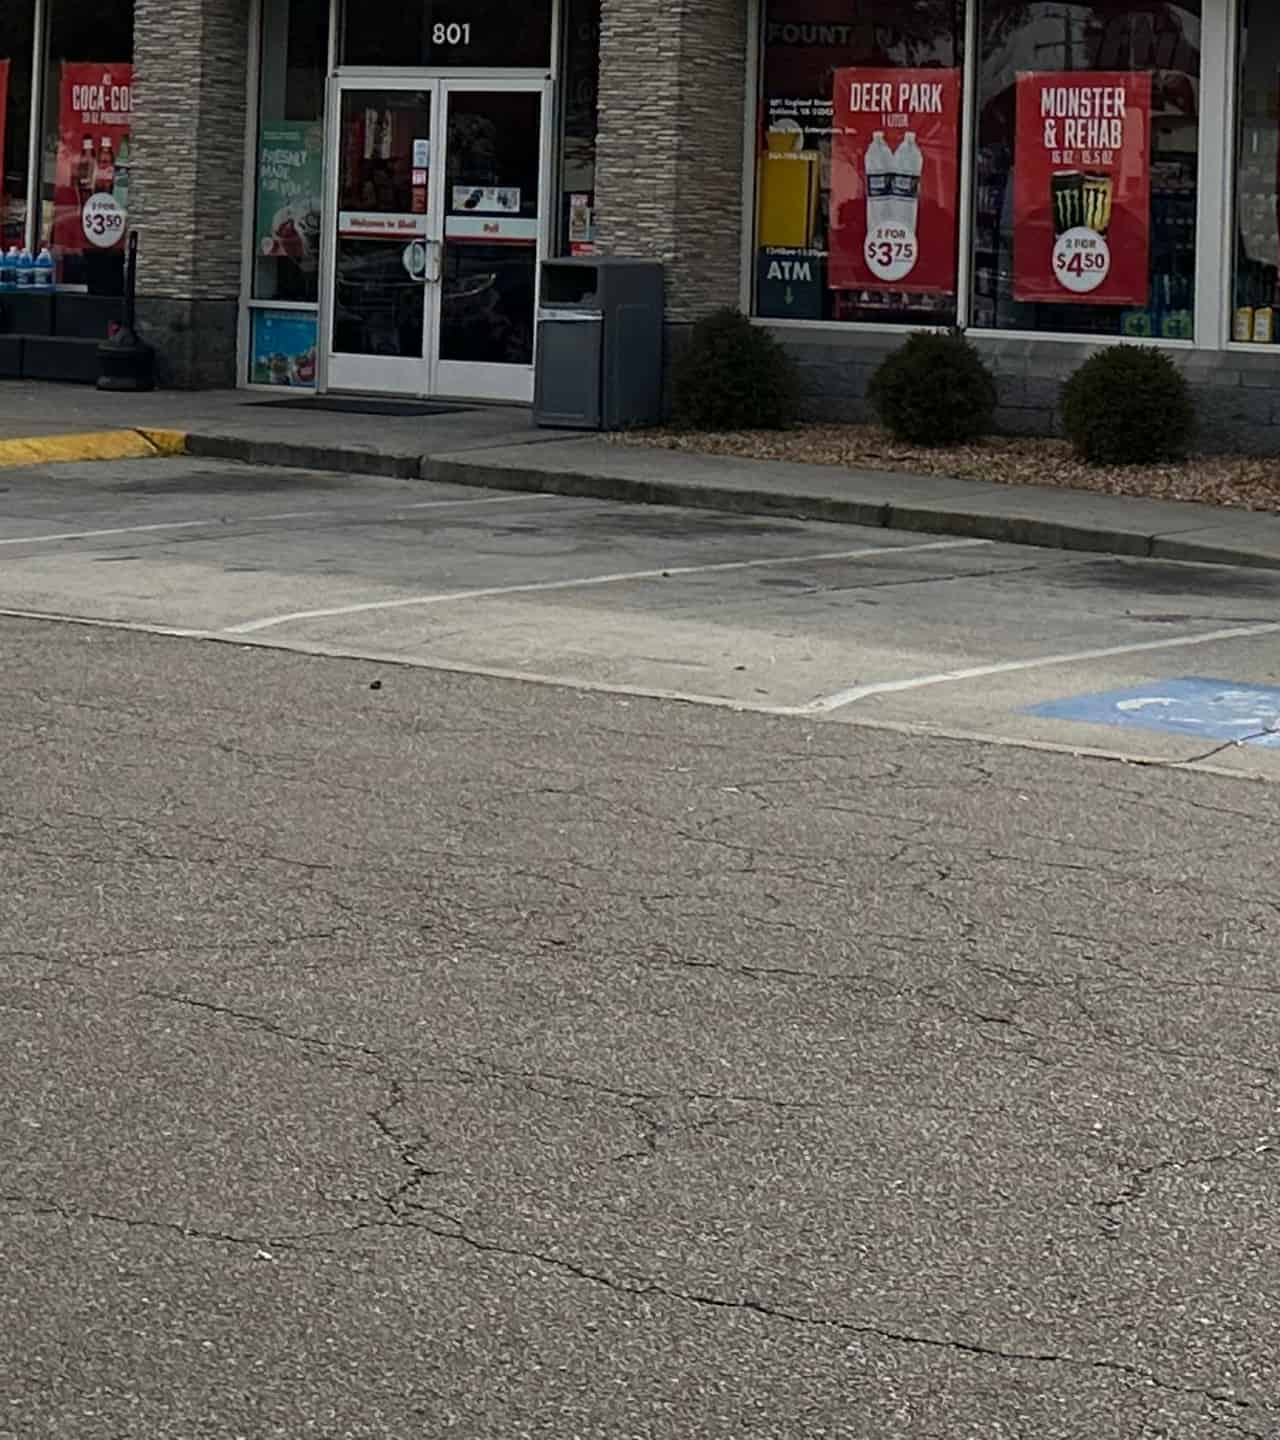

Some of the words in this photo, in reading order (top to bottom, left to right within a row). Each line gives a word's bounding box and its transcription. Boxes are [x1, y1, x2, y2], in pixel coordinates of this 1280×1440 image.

[432, 23, 470, 45] 801
[850, 83, 892, 113] DEER
[898, 83, 943, 113] PARK
[1040, 87, 1127, 118] MONSTER
[1044, 118, 1057, 149] &
[1064, 119, 1123, 150] REHAB
[885, 229, 906, 239] FOR
[1075, 240, 1096, 249] FOR
[767, 261, 812, 282] ATM
